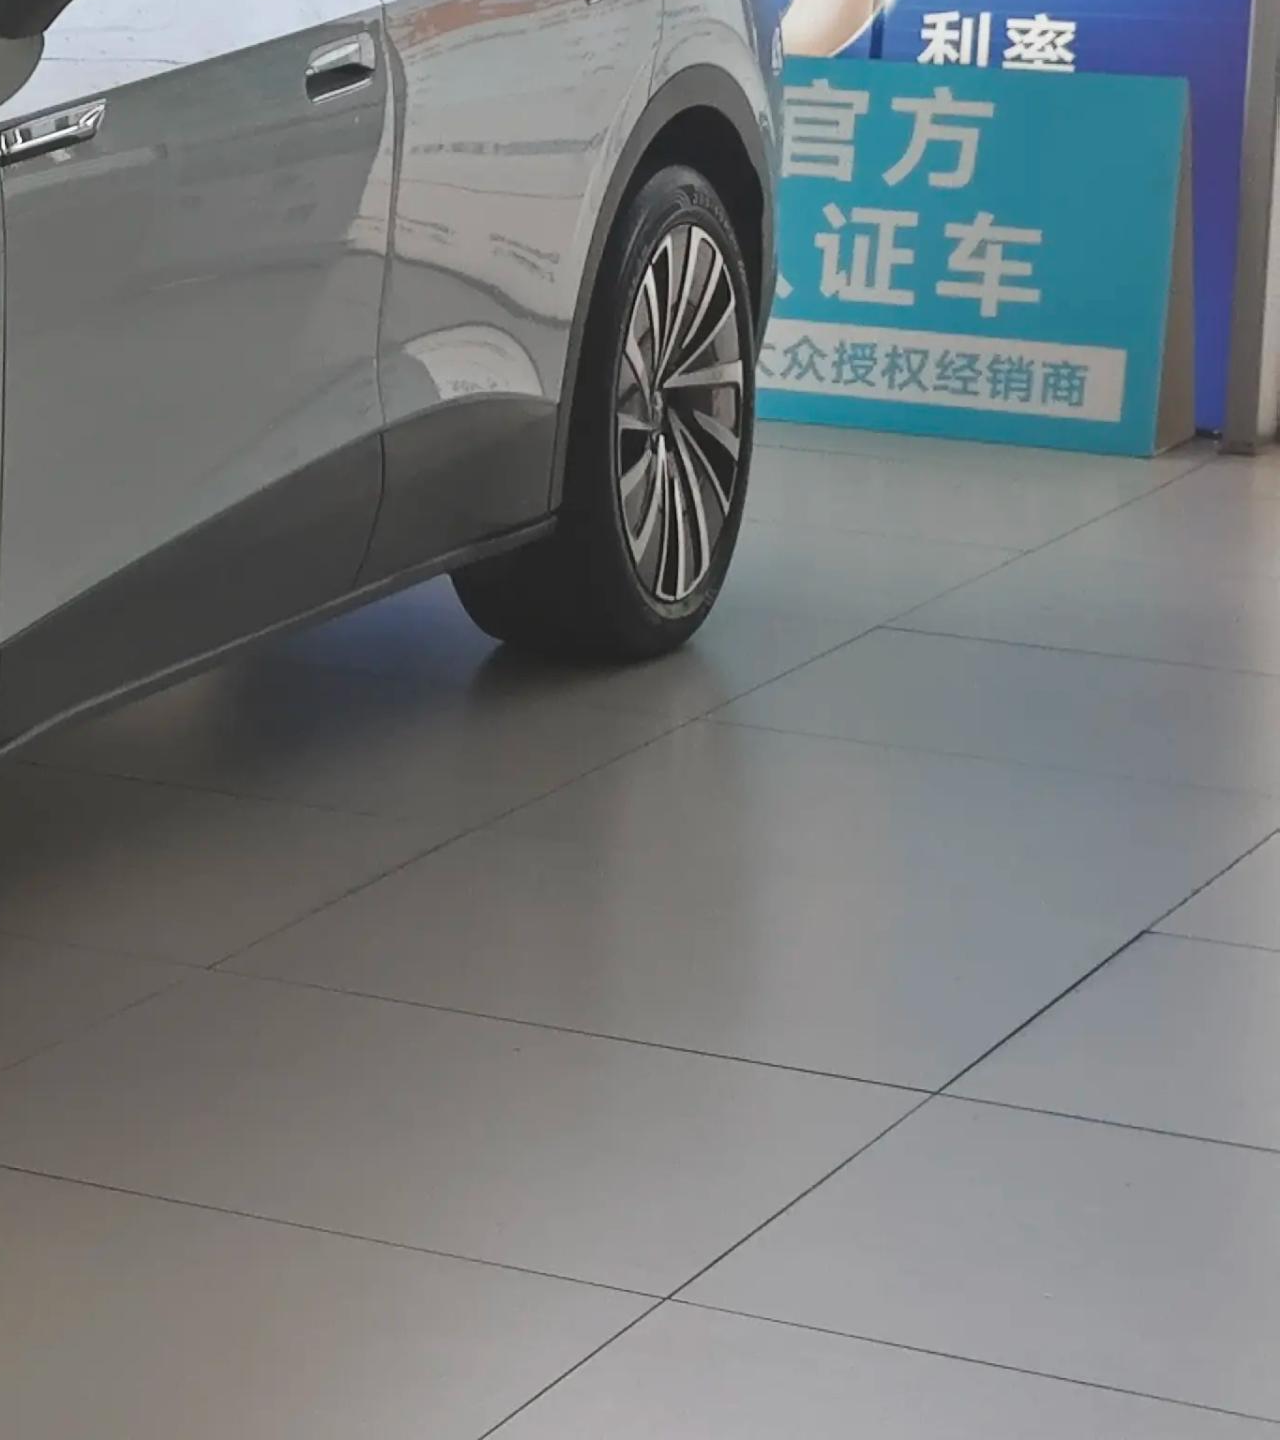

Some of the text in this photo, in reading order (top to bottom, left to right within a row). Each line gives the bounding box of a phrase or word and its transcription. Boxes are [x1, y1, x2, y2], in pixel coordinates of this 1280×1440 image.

[917, 9, 1078, 73] 利率
[781, 78, 995, 189] 官方
[775, 202, 1043, 318] 证车
